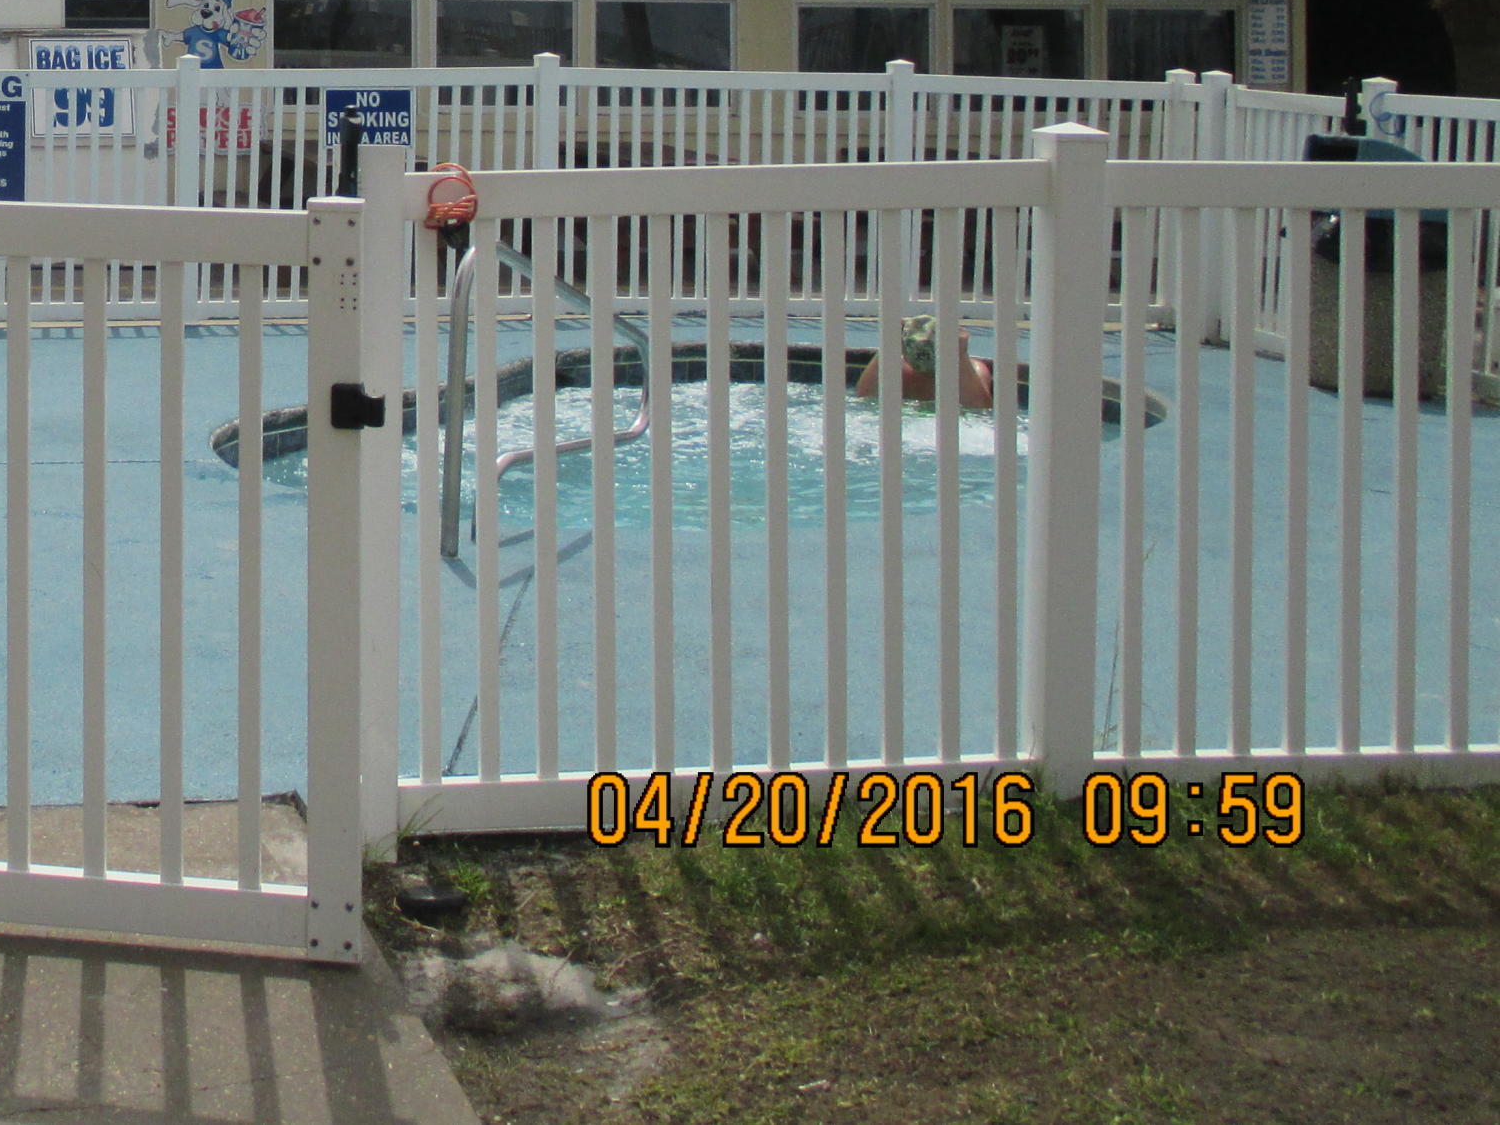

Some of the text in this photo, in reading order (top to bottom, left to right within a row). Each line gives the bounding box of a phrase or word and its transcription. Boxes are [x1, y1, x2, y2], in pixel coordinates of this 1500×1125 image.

[35, 45, 126, 69] BAG ICE
[194, 39, 214, 61] S
[355, 91, 381, 108] NO
[327, 111, 410, 128] SKING
[327, 132, 340, 145] IN
[374, 132, 409, 145] AREA
